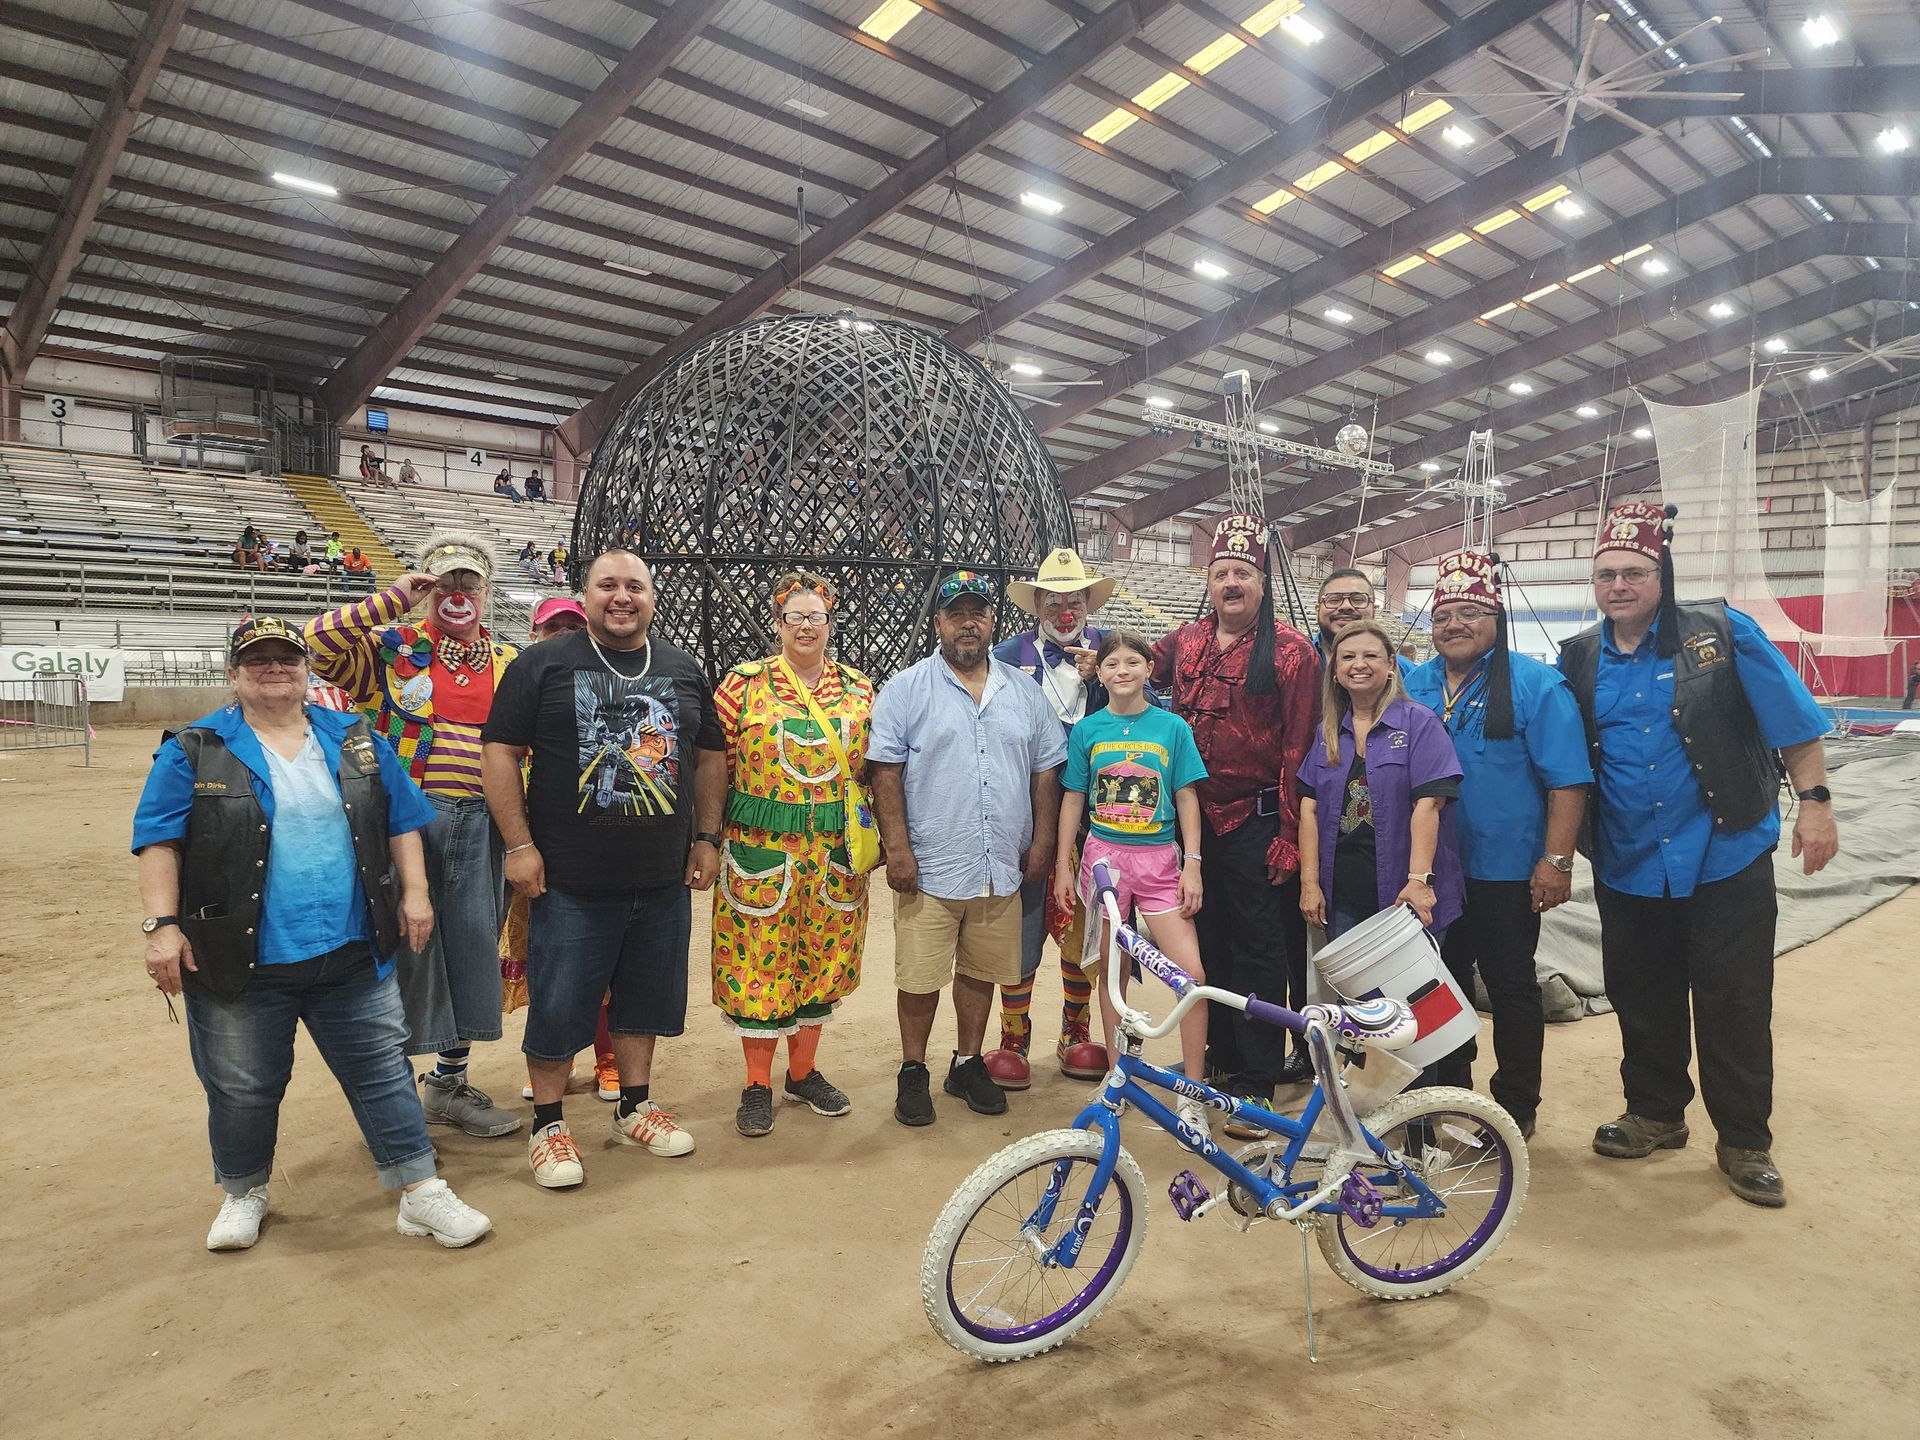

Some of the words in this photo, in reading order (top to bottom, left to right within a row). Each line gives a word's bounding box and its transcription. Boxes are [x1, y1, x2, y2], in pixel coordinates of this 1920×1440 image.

[51, 398, 66, 418] 3
[470, 451, 482, 467] 4
[1119, 533, 1125, 543] 7
[12, 651, 110, 679] Galaly
[1173, 1078, 1205, 1101] BLAZE
[1070, 1235, 1085, 1255] BLAZE
